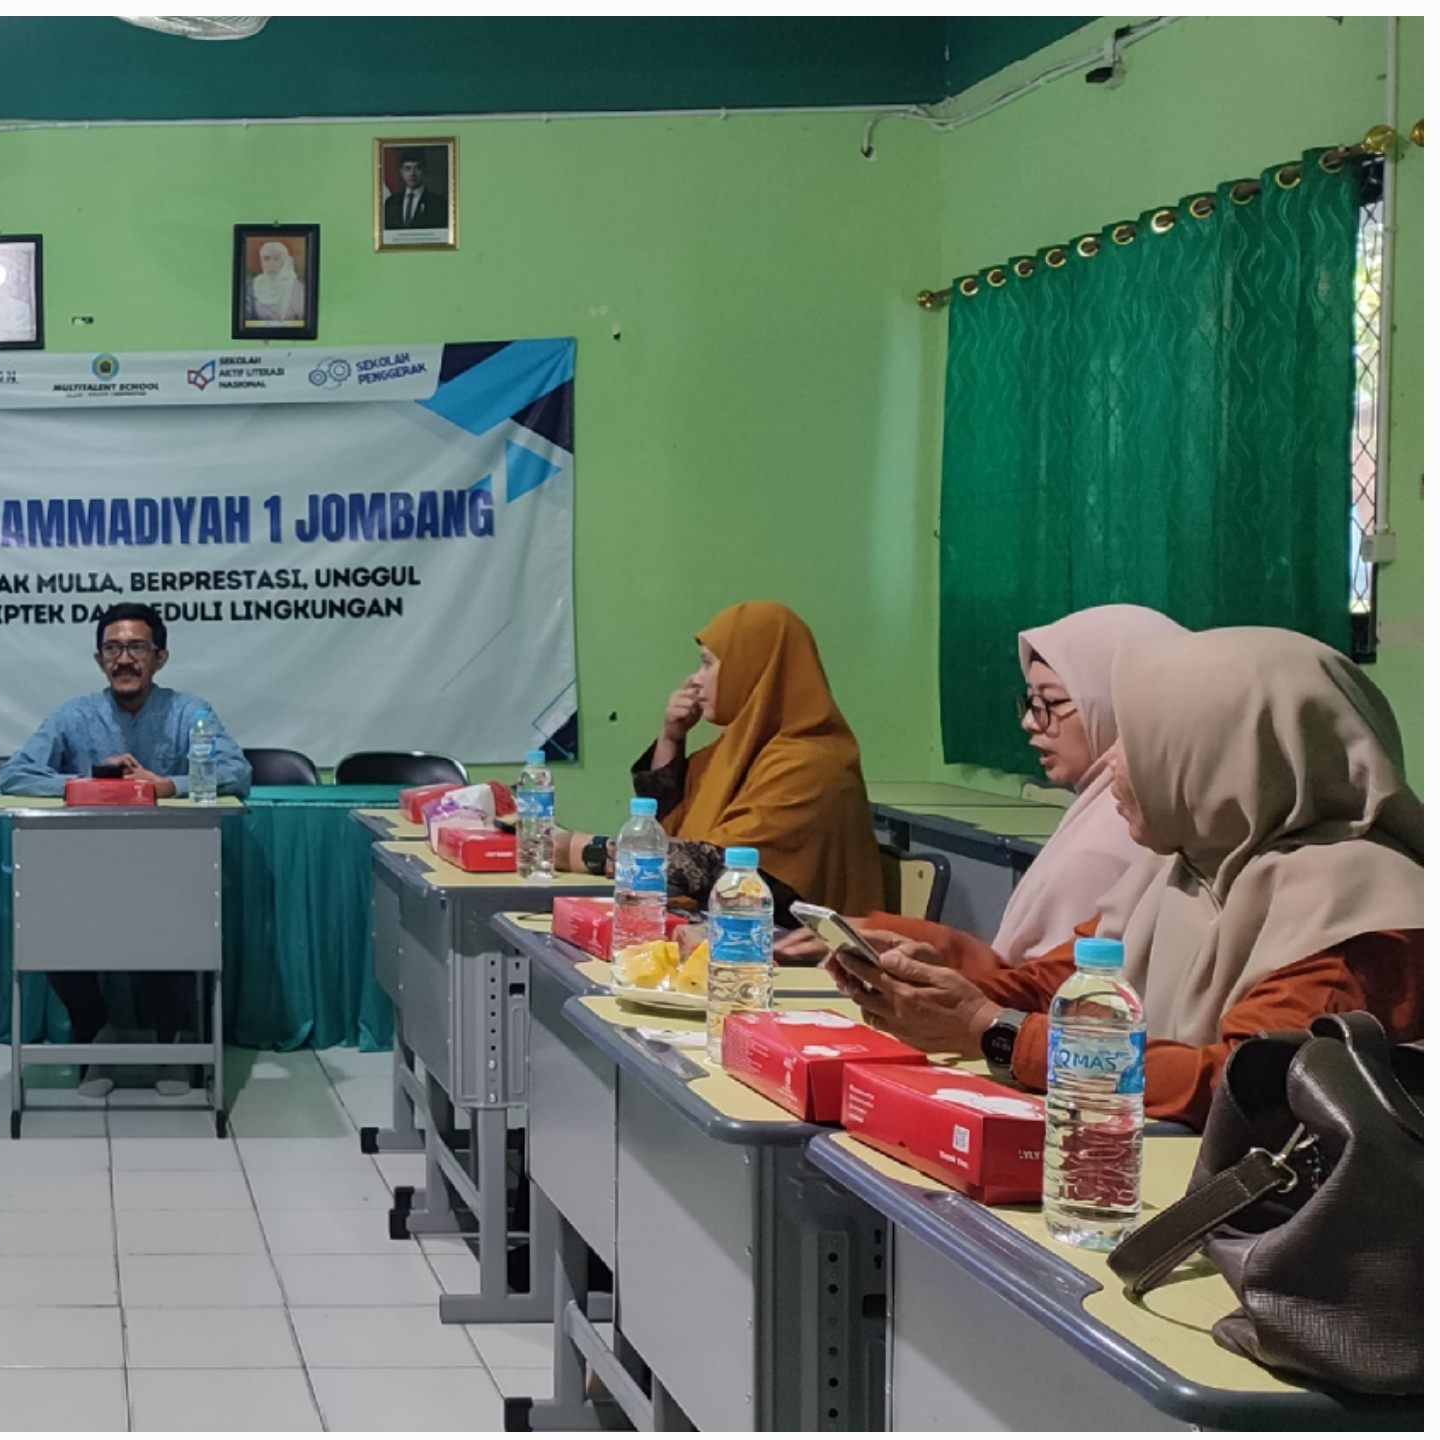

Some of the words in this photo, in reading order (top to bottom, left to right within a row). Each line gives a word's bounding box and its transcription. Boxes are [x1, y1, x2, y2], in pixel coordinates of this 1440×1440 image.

[355, 352, 410, 372] SEKOLAH
[357, 363, 427, 385] PENGGERAK
[52, 383, 118, 391] MULTITALENT
[119, 383, 160, 391] SCHOOL
[264, 495, 282, 543] 1
[295, 489, 495, 543] JOMBANG
[37, 572, 124, 596] MULIA,
[131, 569, 309, 592] BERPRESTASI,
[315, 565, 421, 587] UNGGUL
[72, 604, 112, 624] DA
[230, 597, 403, 621] LINGKUNGAN
